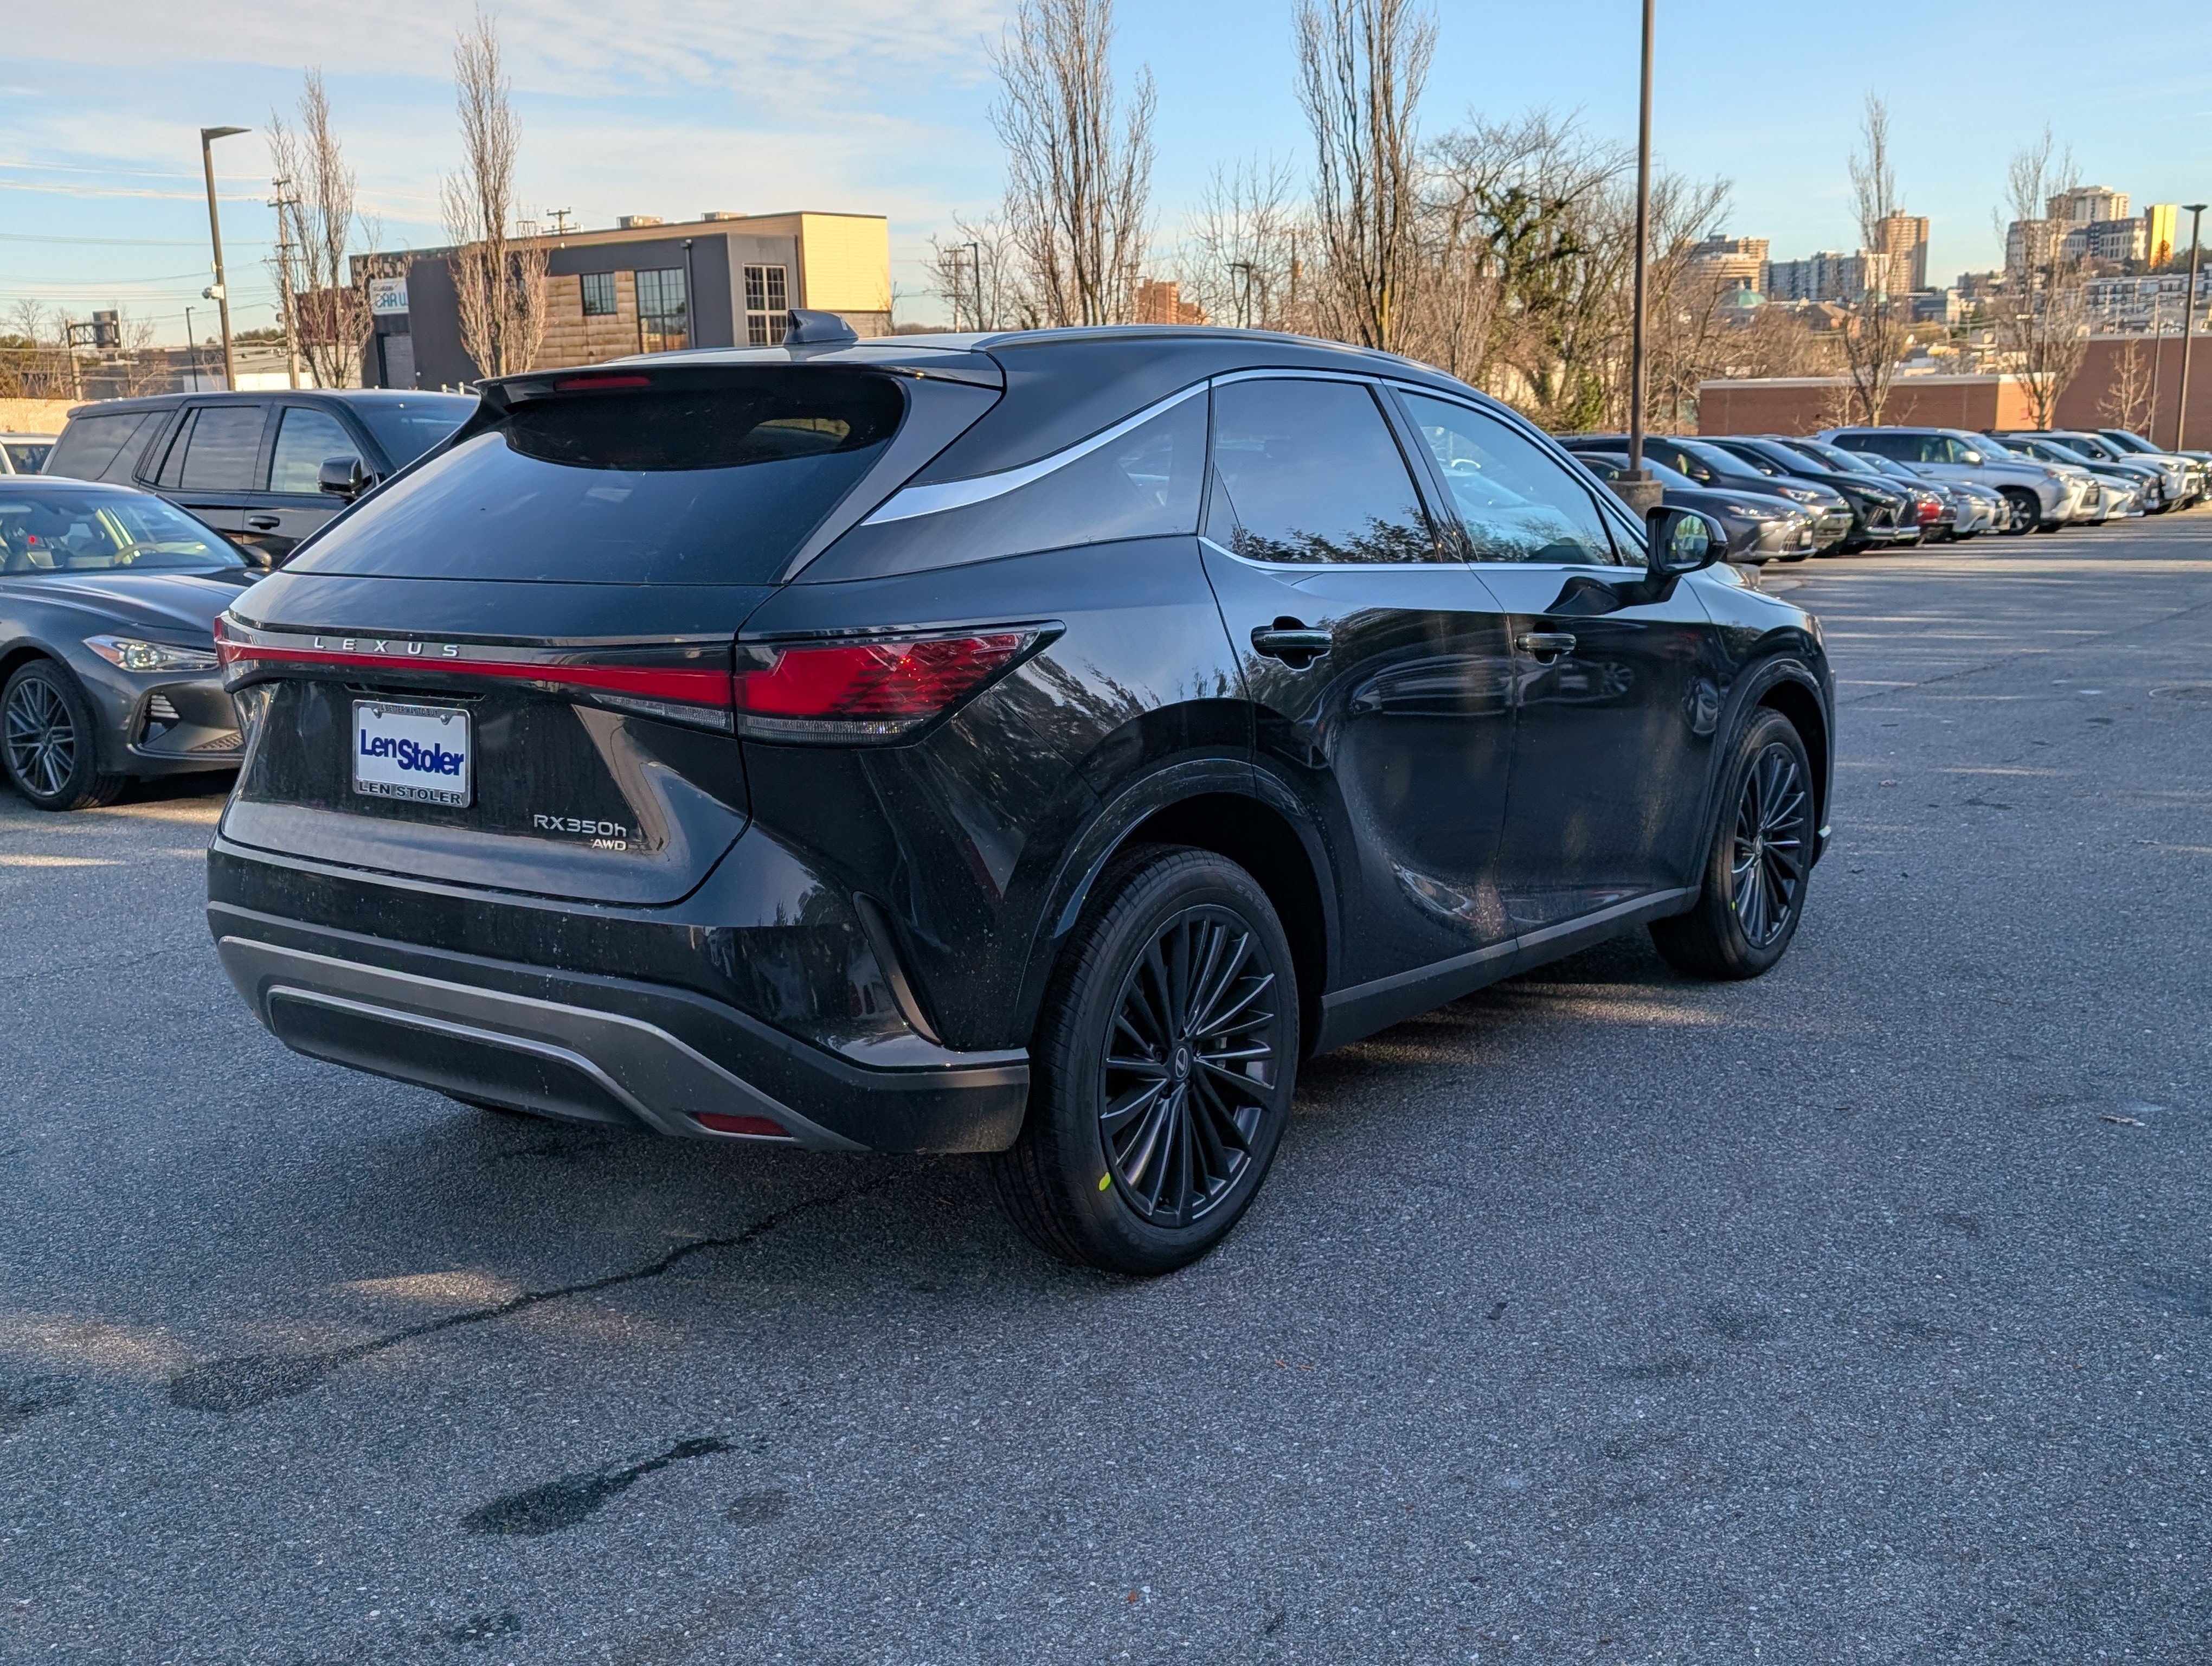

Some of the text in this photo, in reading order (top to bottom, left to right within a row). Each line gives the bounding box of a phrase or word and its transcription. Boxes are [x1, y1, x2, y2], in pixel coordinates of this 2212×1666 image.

[314, 637, 460, 657] LEXUS
[358, 781, 461, 804] LEN STOLER
[533, 814, 627, 837] RX350h
[591, 838, 627, 851] AWD
